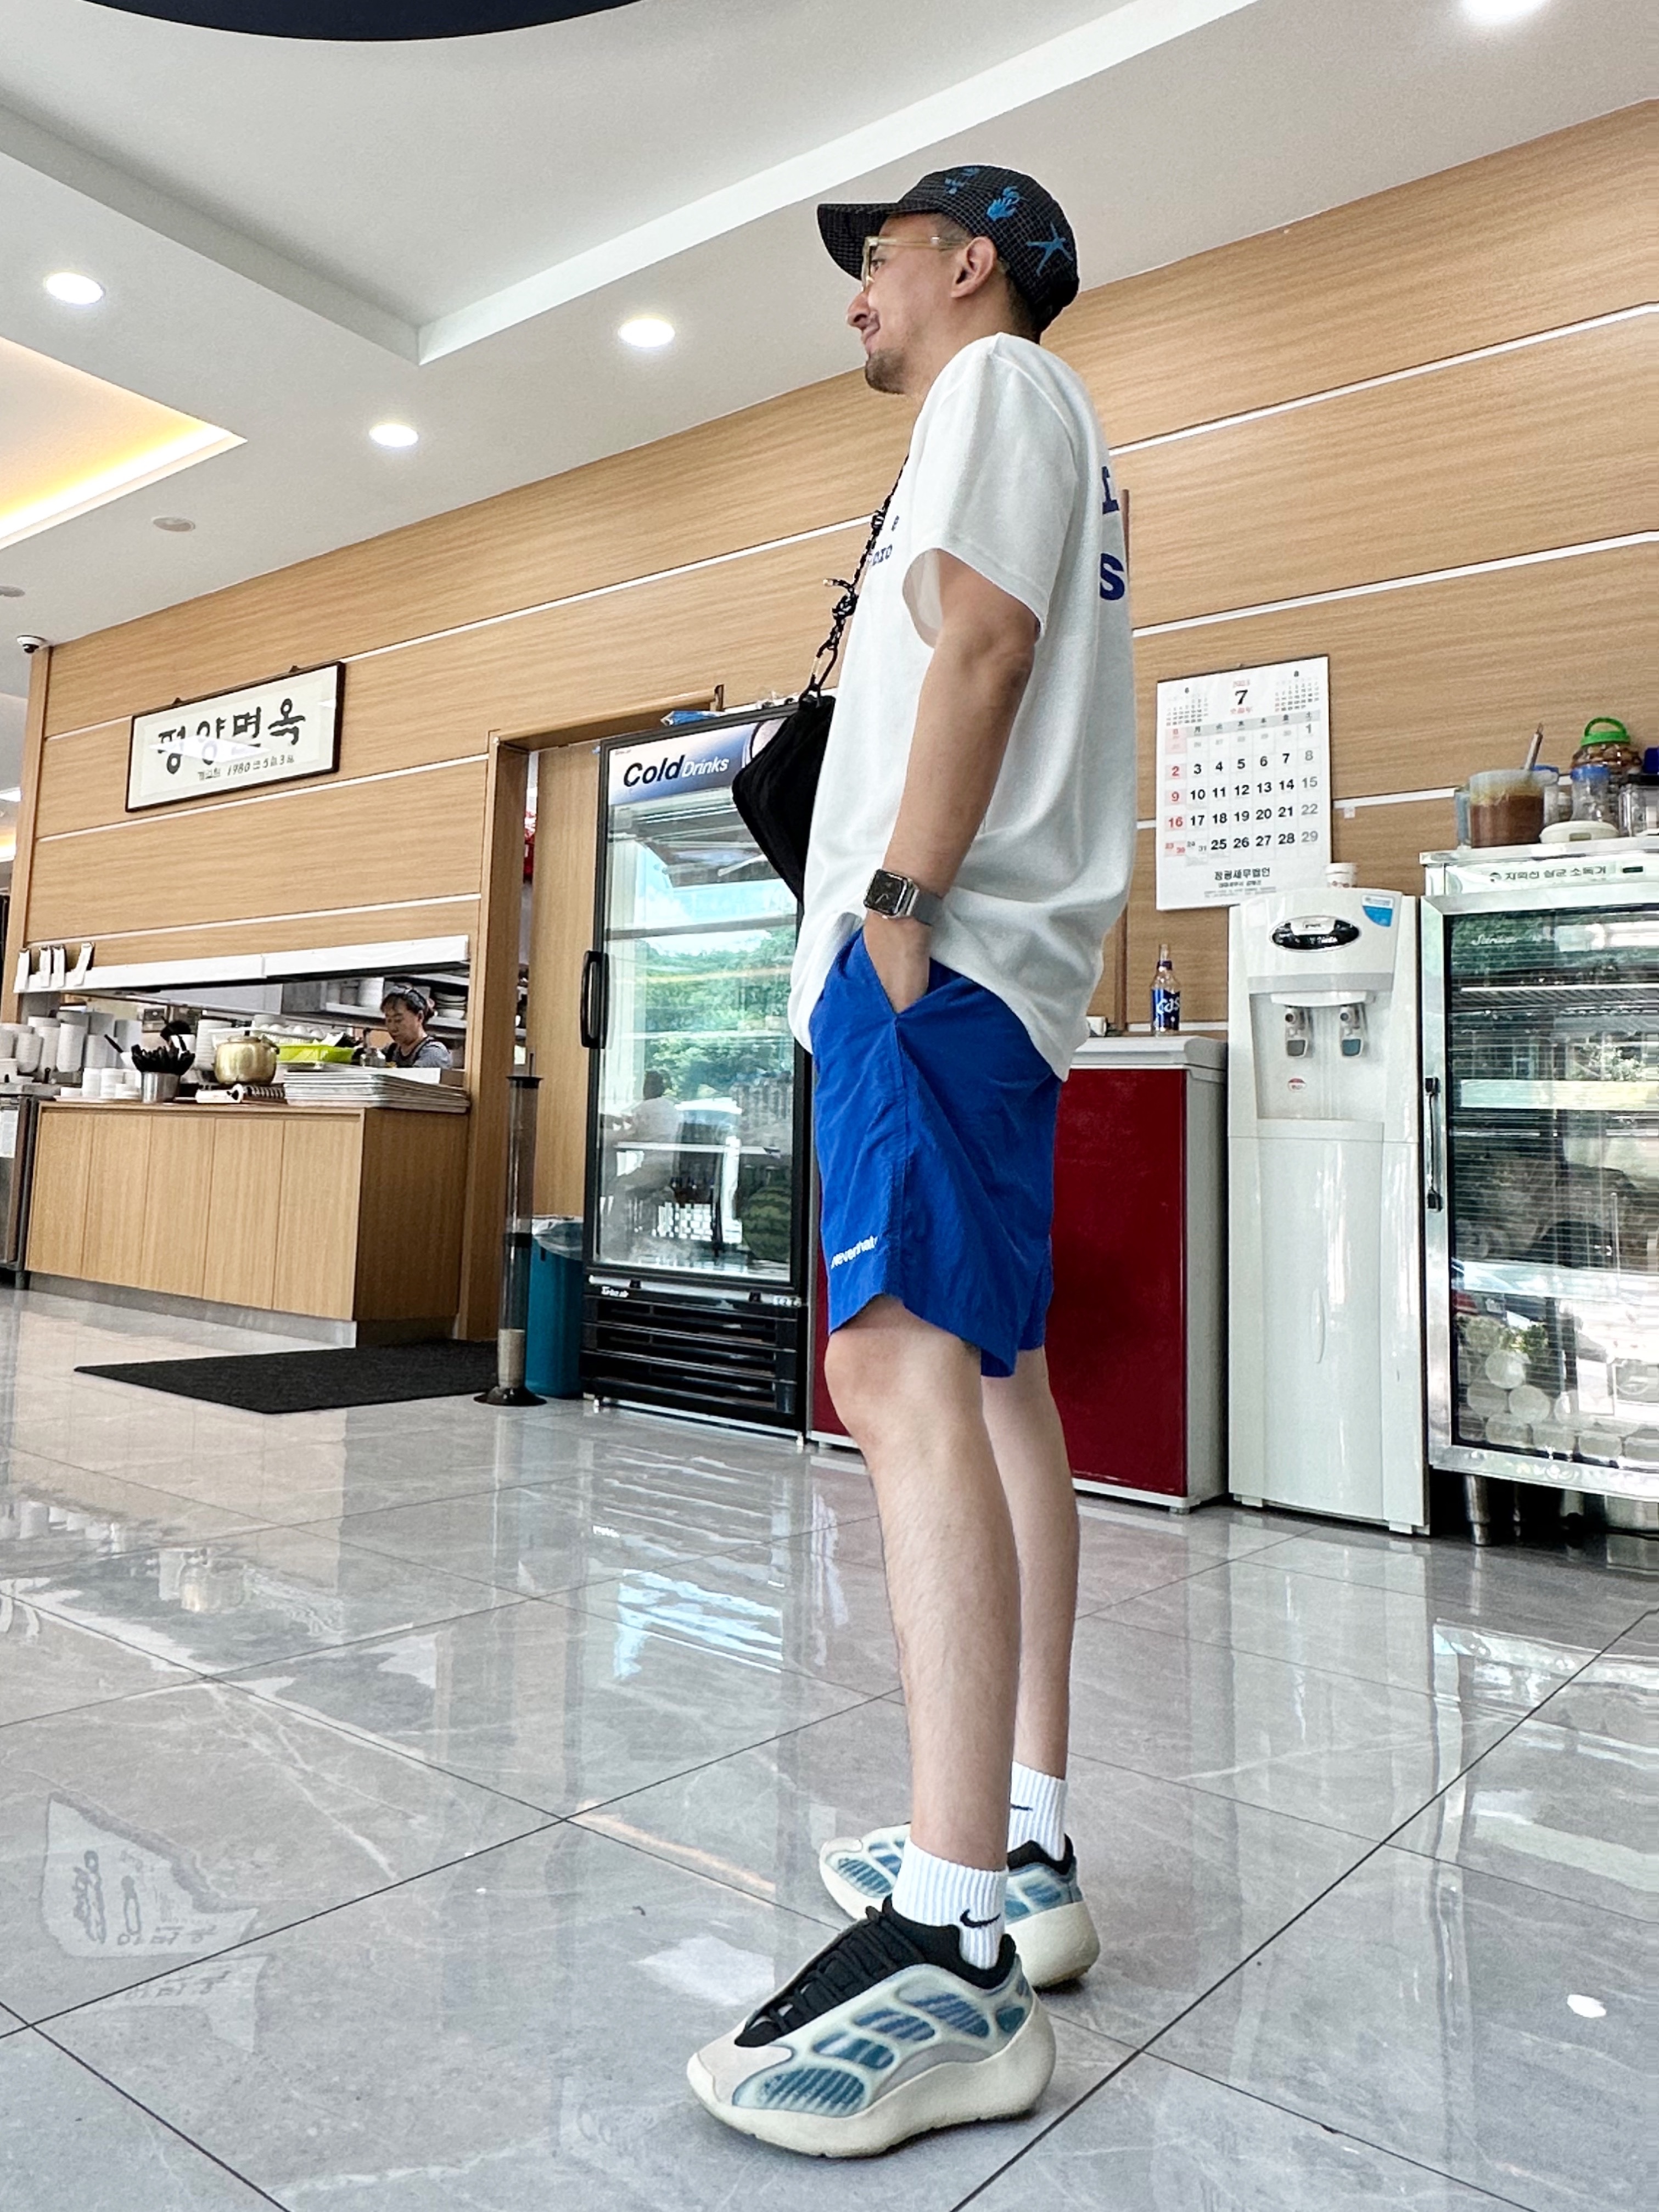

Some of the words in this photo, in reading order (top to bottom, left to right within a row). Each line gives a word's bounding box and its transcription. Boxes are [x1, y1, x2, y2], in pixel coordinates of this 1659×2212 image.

[1235, 689, 1248, 705] 7
[1305, 723, 1311, 734] 1
[624, 754, 686, 787] Cold
[681, 756, 730, 778] Drinks
[1172, 766, 1180, 776] 2
[1193, 763, 1202, 774] 3
[1215, 761, 1223, 772] 4
[1237, 759, 1246, 769] 5
[1260, 756, 1268, 767] 6
[1282, 753, 1290, 763] 7
[1305, 750, 1313, 761] 8
[1172, 791, 1180, 801] 9
[1190, 789, 1206, 800] 10
[1212, 787, 1226, 798] 11
[1234, 784, 1250, 796] 12
[1257, 782, 1272, 793] 13
[1279, 778, 1294, 790] 14
[1302, 776, 1318, 788] 15
[1168, 816, 1183, 827] 16
[1190, 815, 1205, 826] 17
[1212, 812, 1228, 824] 18
[1234, 811, 1250, 822] 19
[1256, 808, 1272, 820] 20
[1277, 805, 1293, 818] 21
[1301, 803, 1318, 816] 22
[1210, 839, 1228, 850] 25
[1233, 837, 1250, 849] 26
[1256, 835, 1271, 846] 27
[1278, 833, 1295, 845] 28
[1301, 830, 1319, 843] 29
[1157, 997, 1180, 1015] Cas
